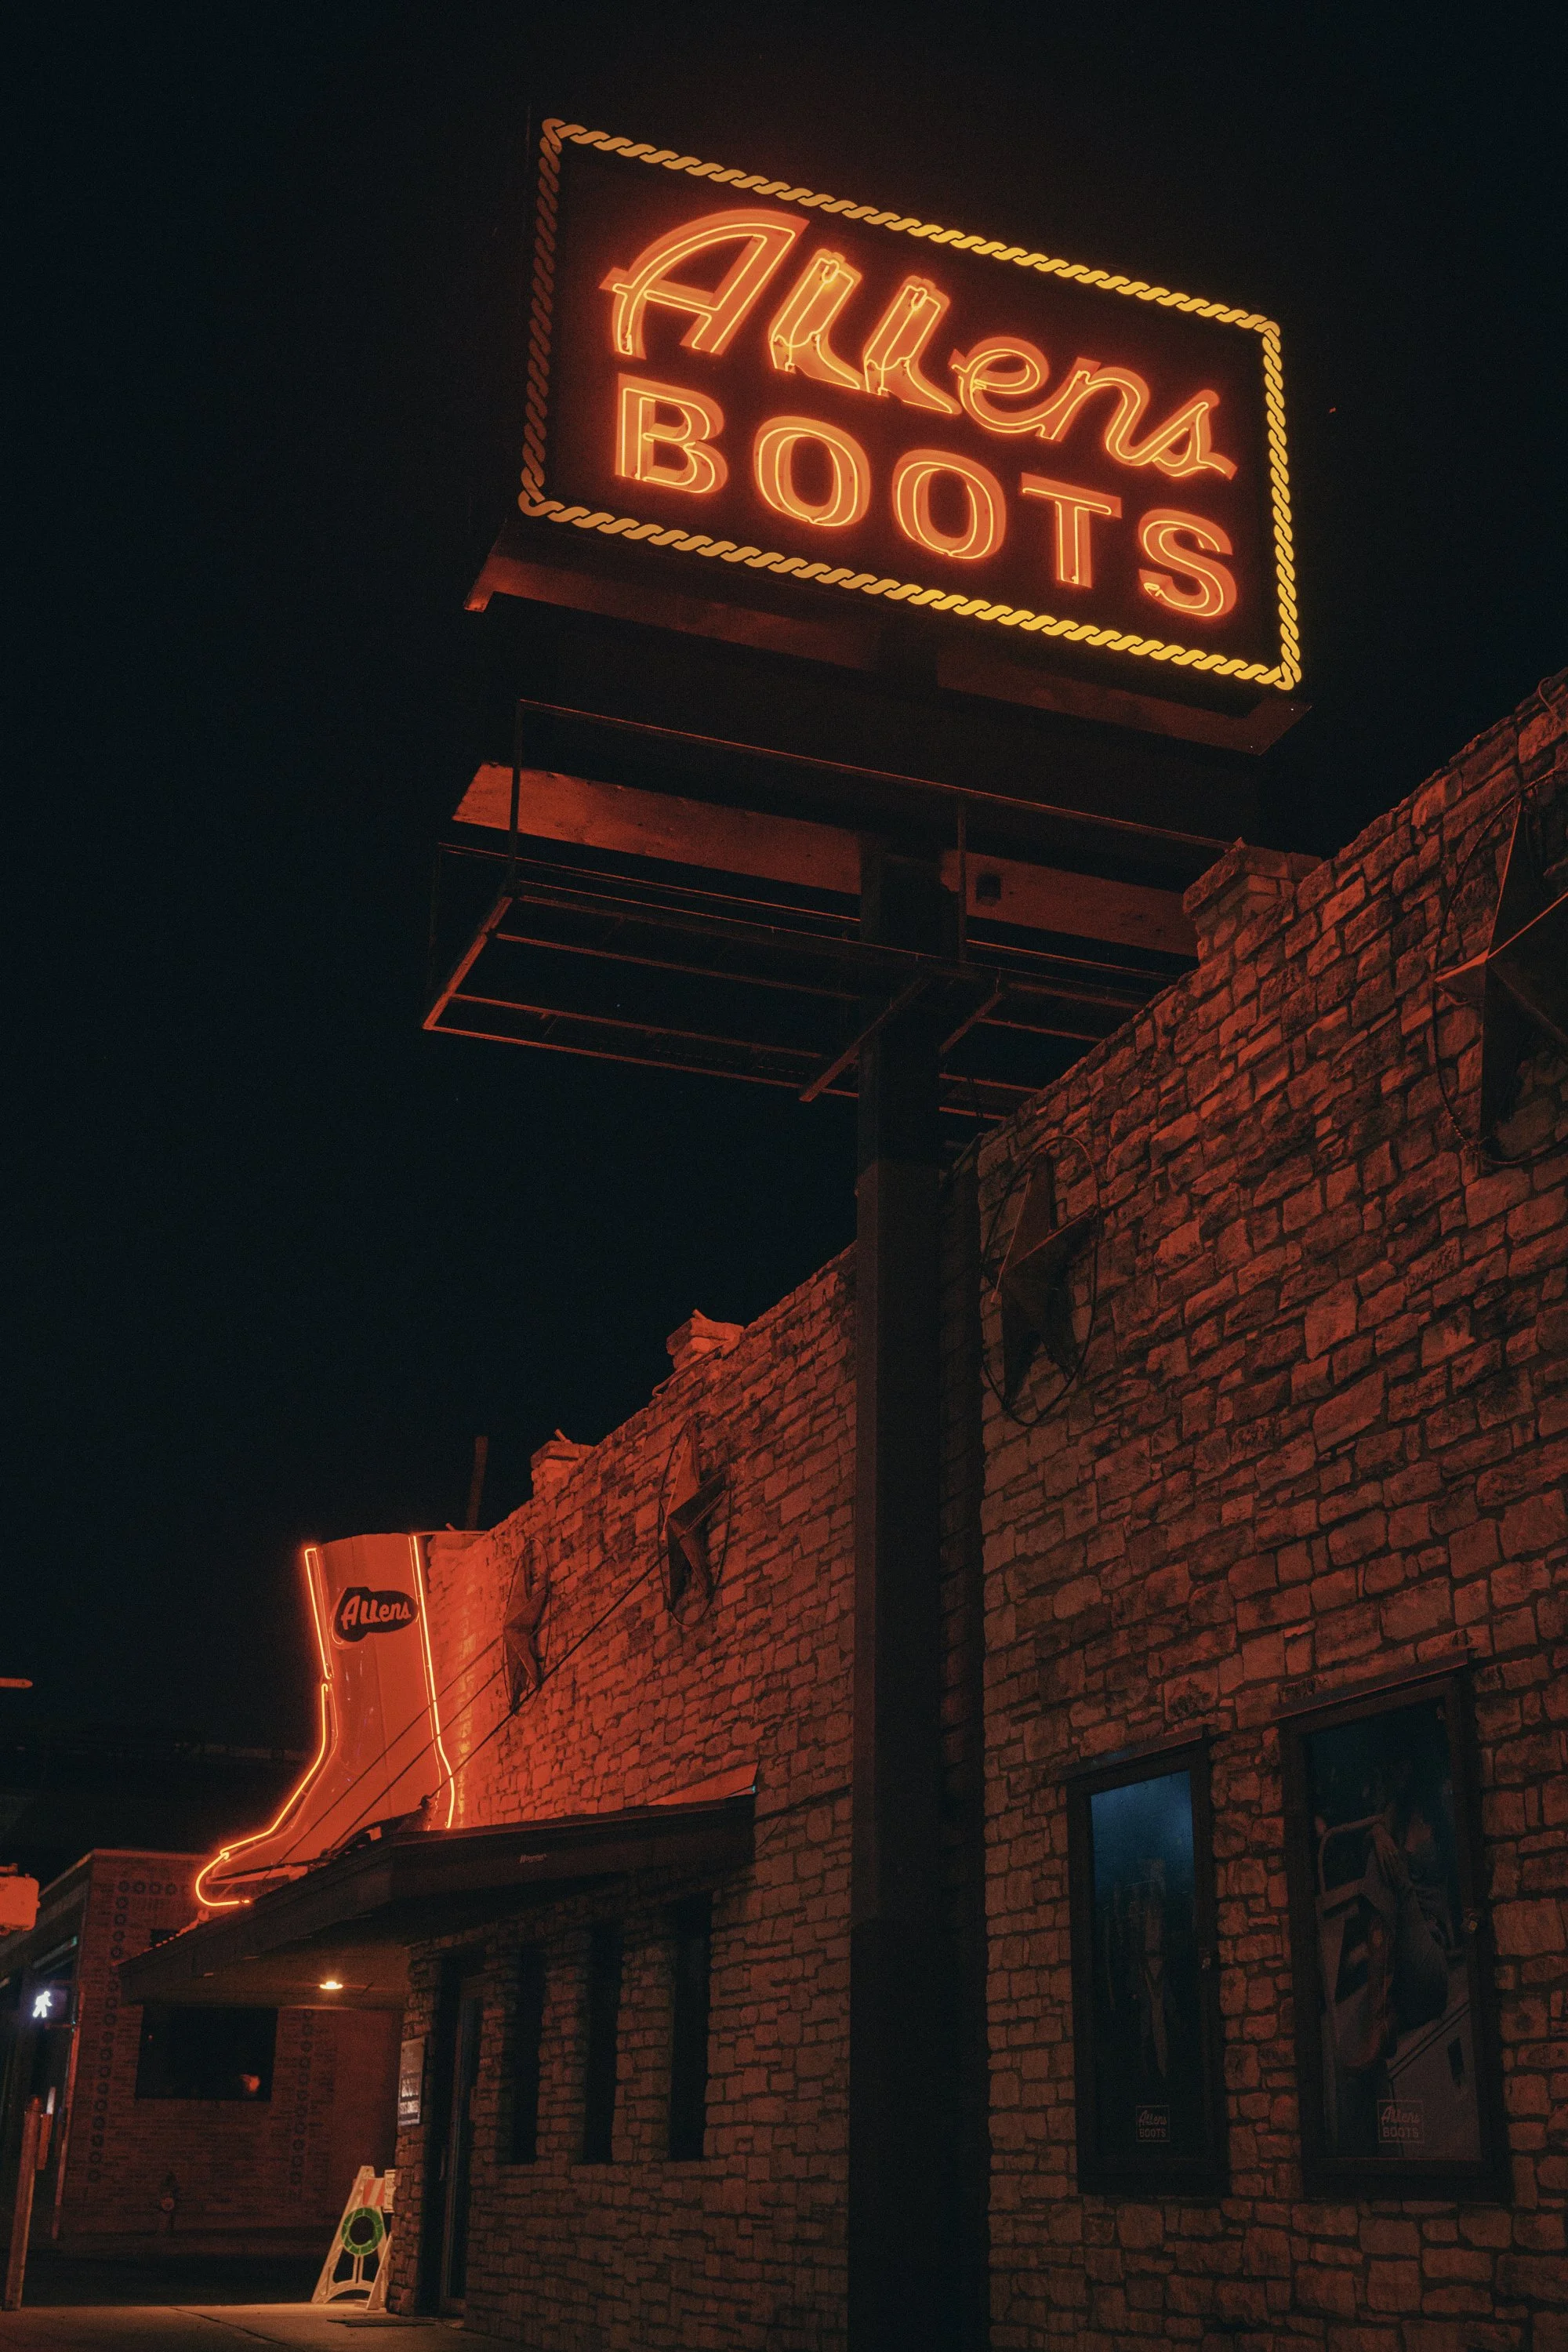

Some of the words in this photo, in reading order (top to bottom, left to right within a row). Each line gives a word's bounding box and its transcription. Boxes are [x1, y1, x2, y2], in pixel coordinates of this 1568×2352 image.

[599, 209, 1237, 480] Allens
[615, 373, 1236, 616] BOOTS
[341, 1595, 412, 1630] Allens
[1139, 2129, 1167, 2137] BOOTS
[1383, 2127, 1419, 2138] BOOTS
